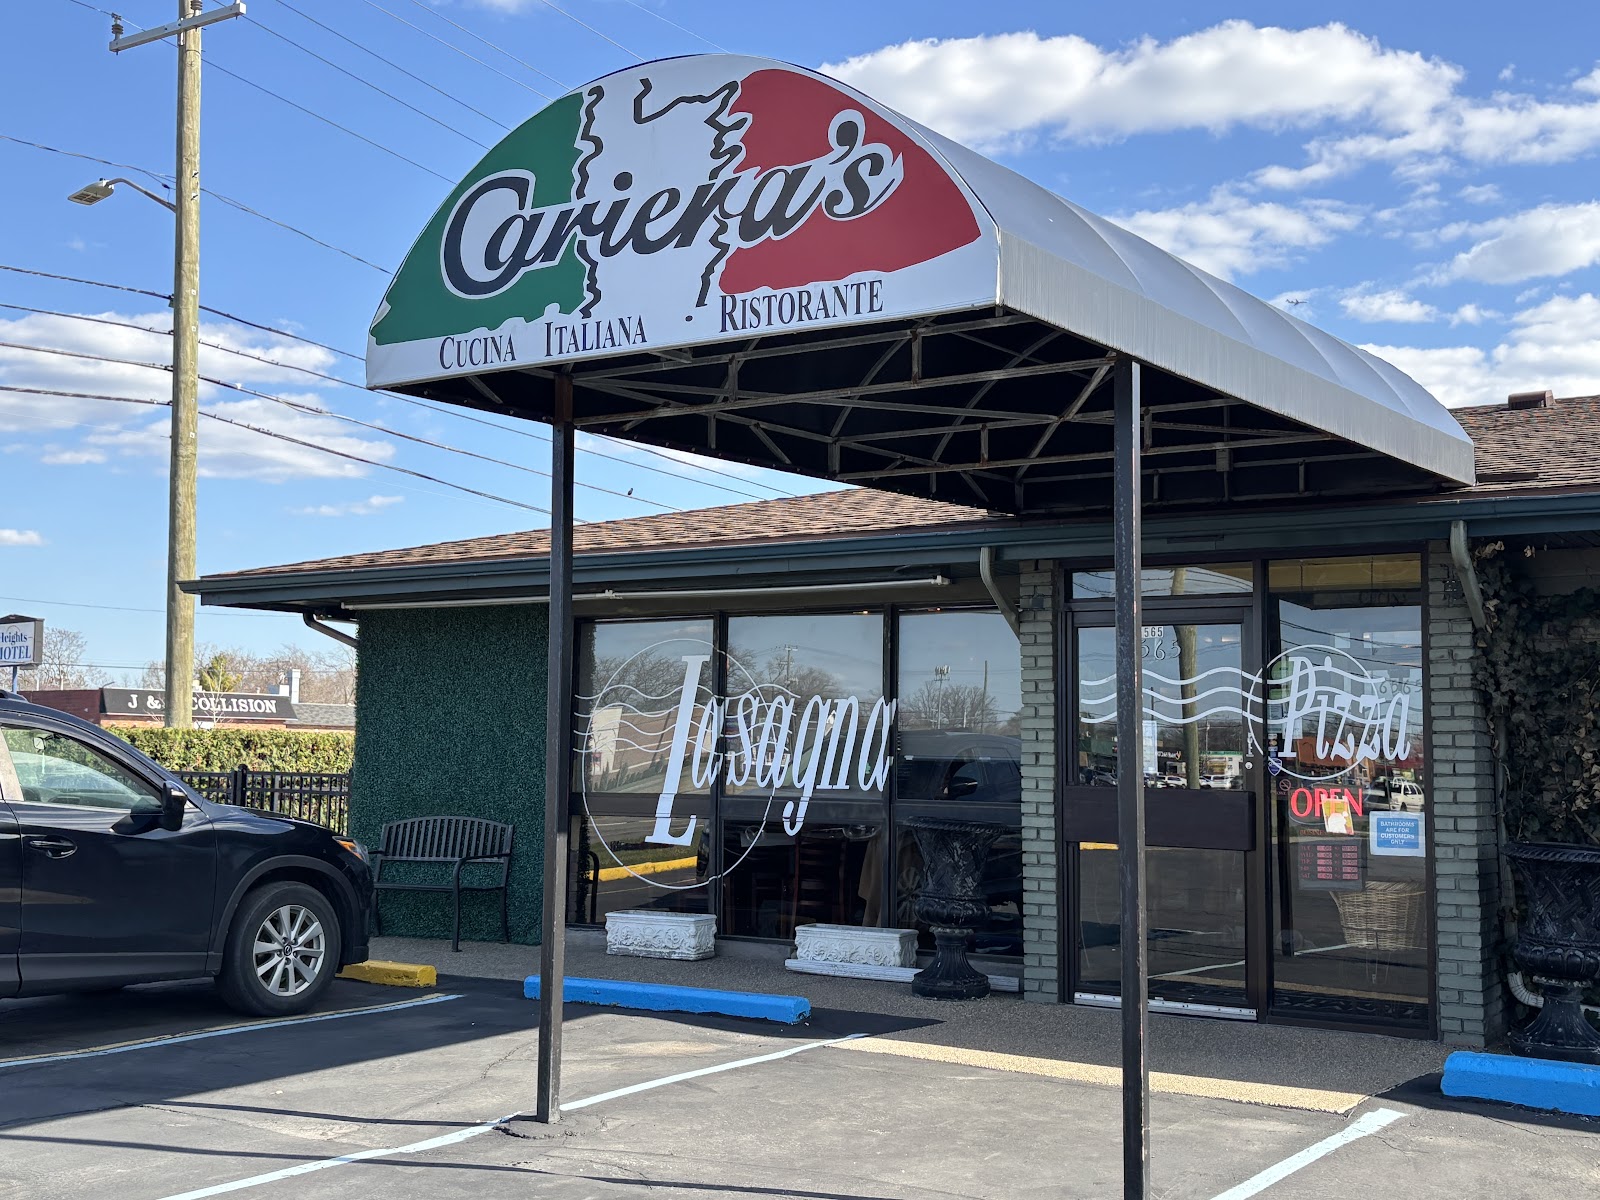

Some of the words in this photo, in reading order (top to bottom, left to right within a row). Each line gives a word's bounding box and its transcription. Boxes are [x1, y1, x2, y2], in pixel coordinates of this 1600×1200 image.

[443, 120, 896, 296] Cariera's
[439, 334, 517, 370] CUCINA
[544, 314, 648, 358] ITALIANA
[719, 279, 884, 333] RISTORANTE
[128, 694, 138, 709] J
[146, 695, 162, 709] &
[645, 654, 900, 847] Lasagna
[1278, 656, 1411, 761] Pizza
[1380, 820, 1415, 828] BATHROOMS
